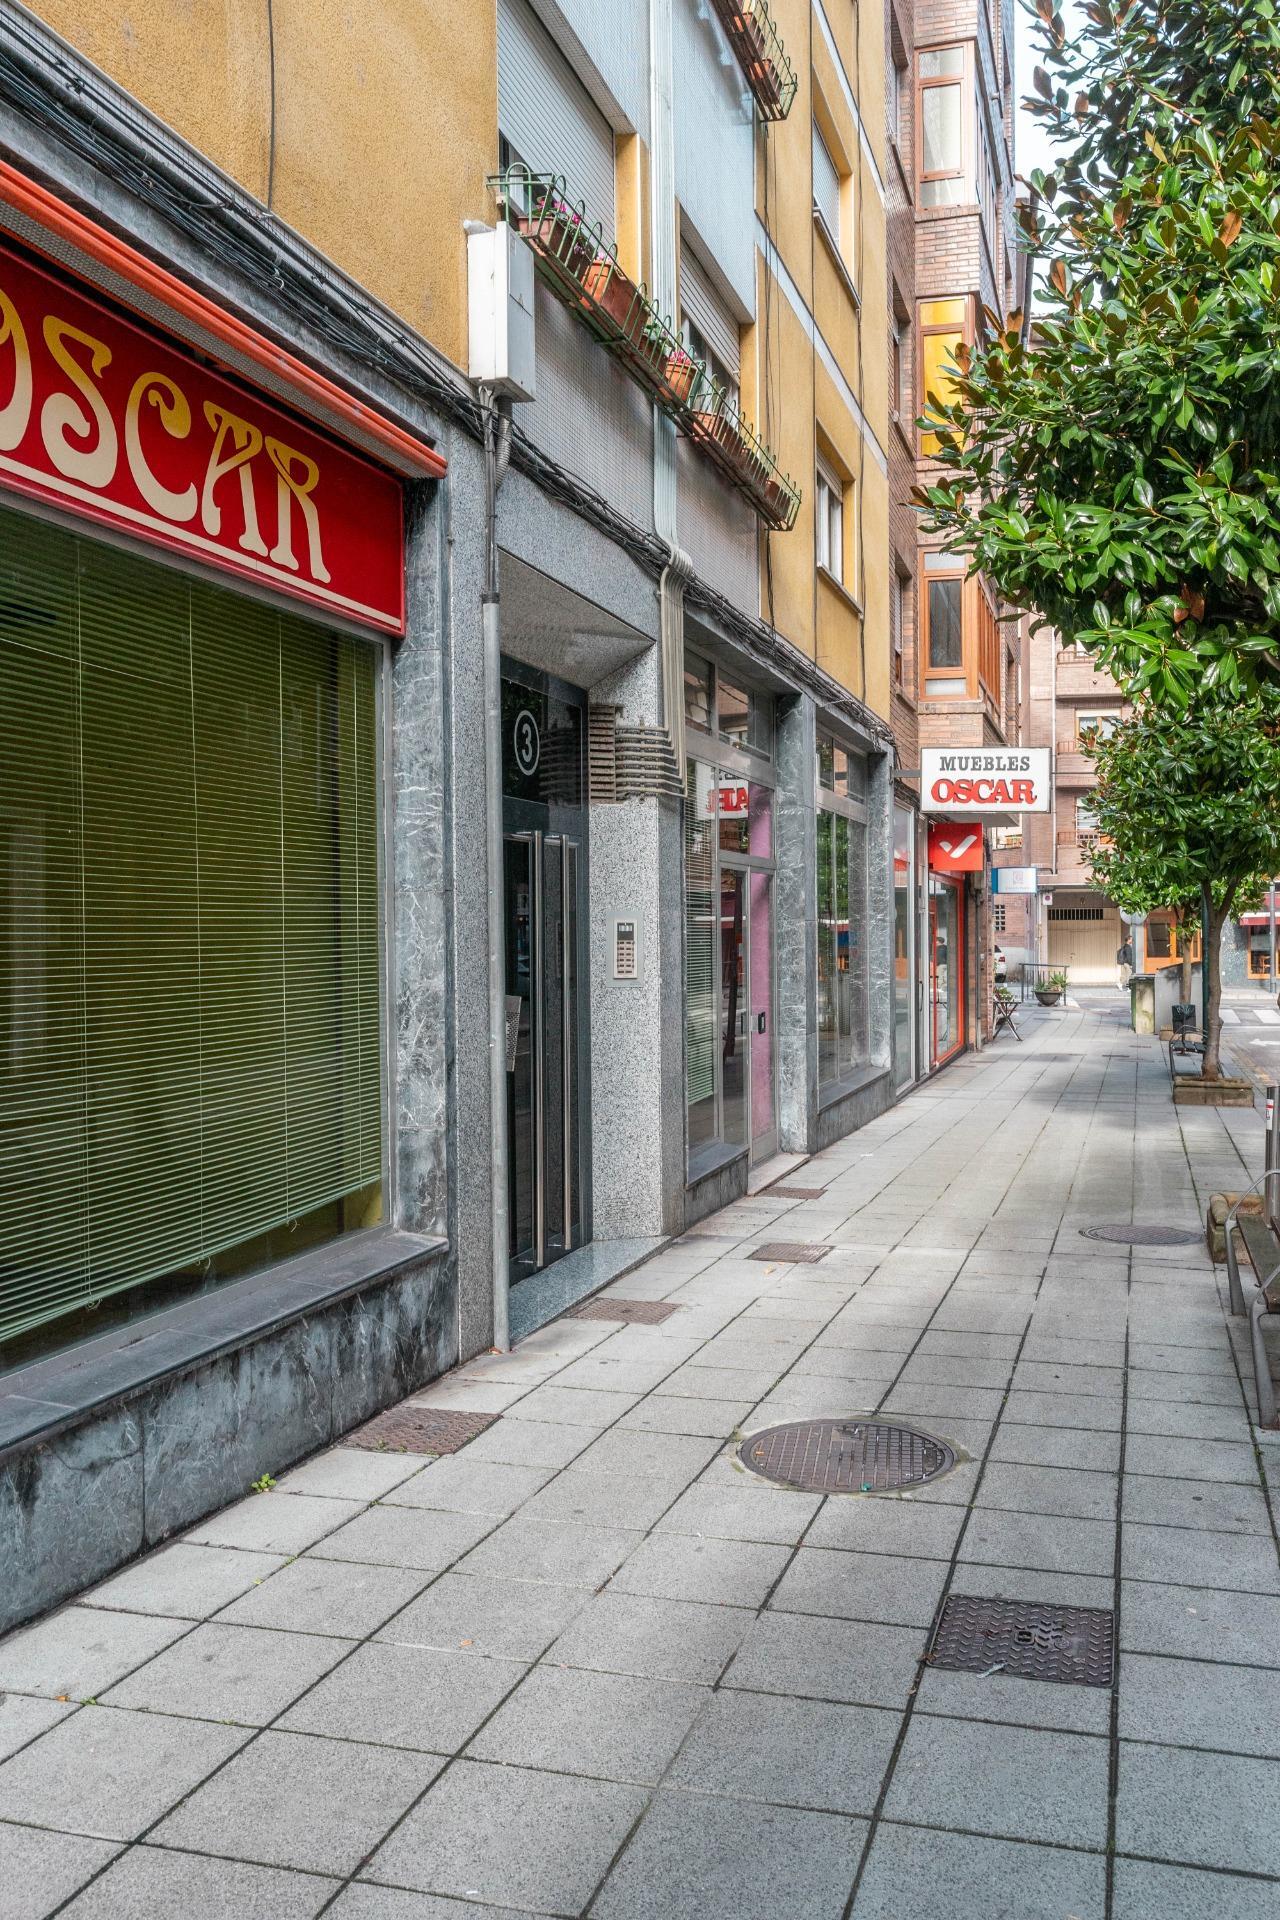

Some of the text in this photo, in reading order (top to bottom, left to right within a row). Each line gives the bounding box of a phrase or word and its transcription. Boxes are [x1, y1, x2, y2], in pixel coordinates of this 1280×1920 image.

[521, 723, 533, 763] 3
[939, 756, 1030, 771] MUEBLES
[931, 778, 1037, 804] OSCAR
